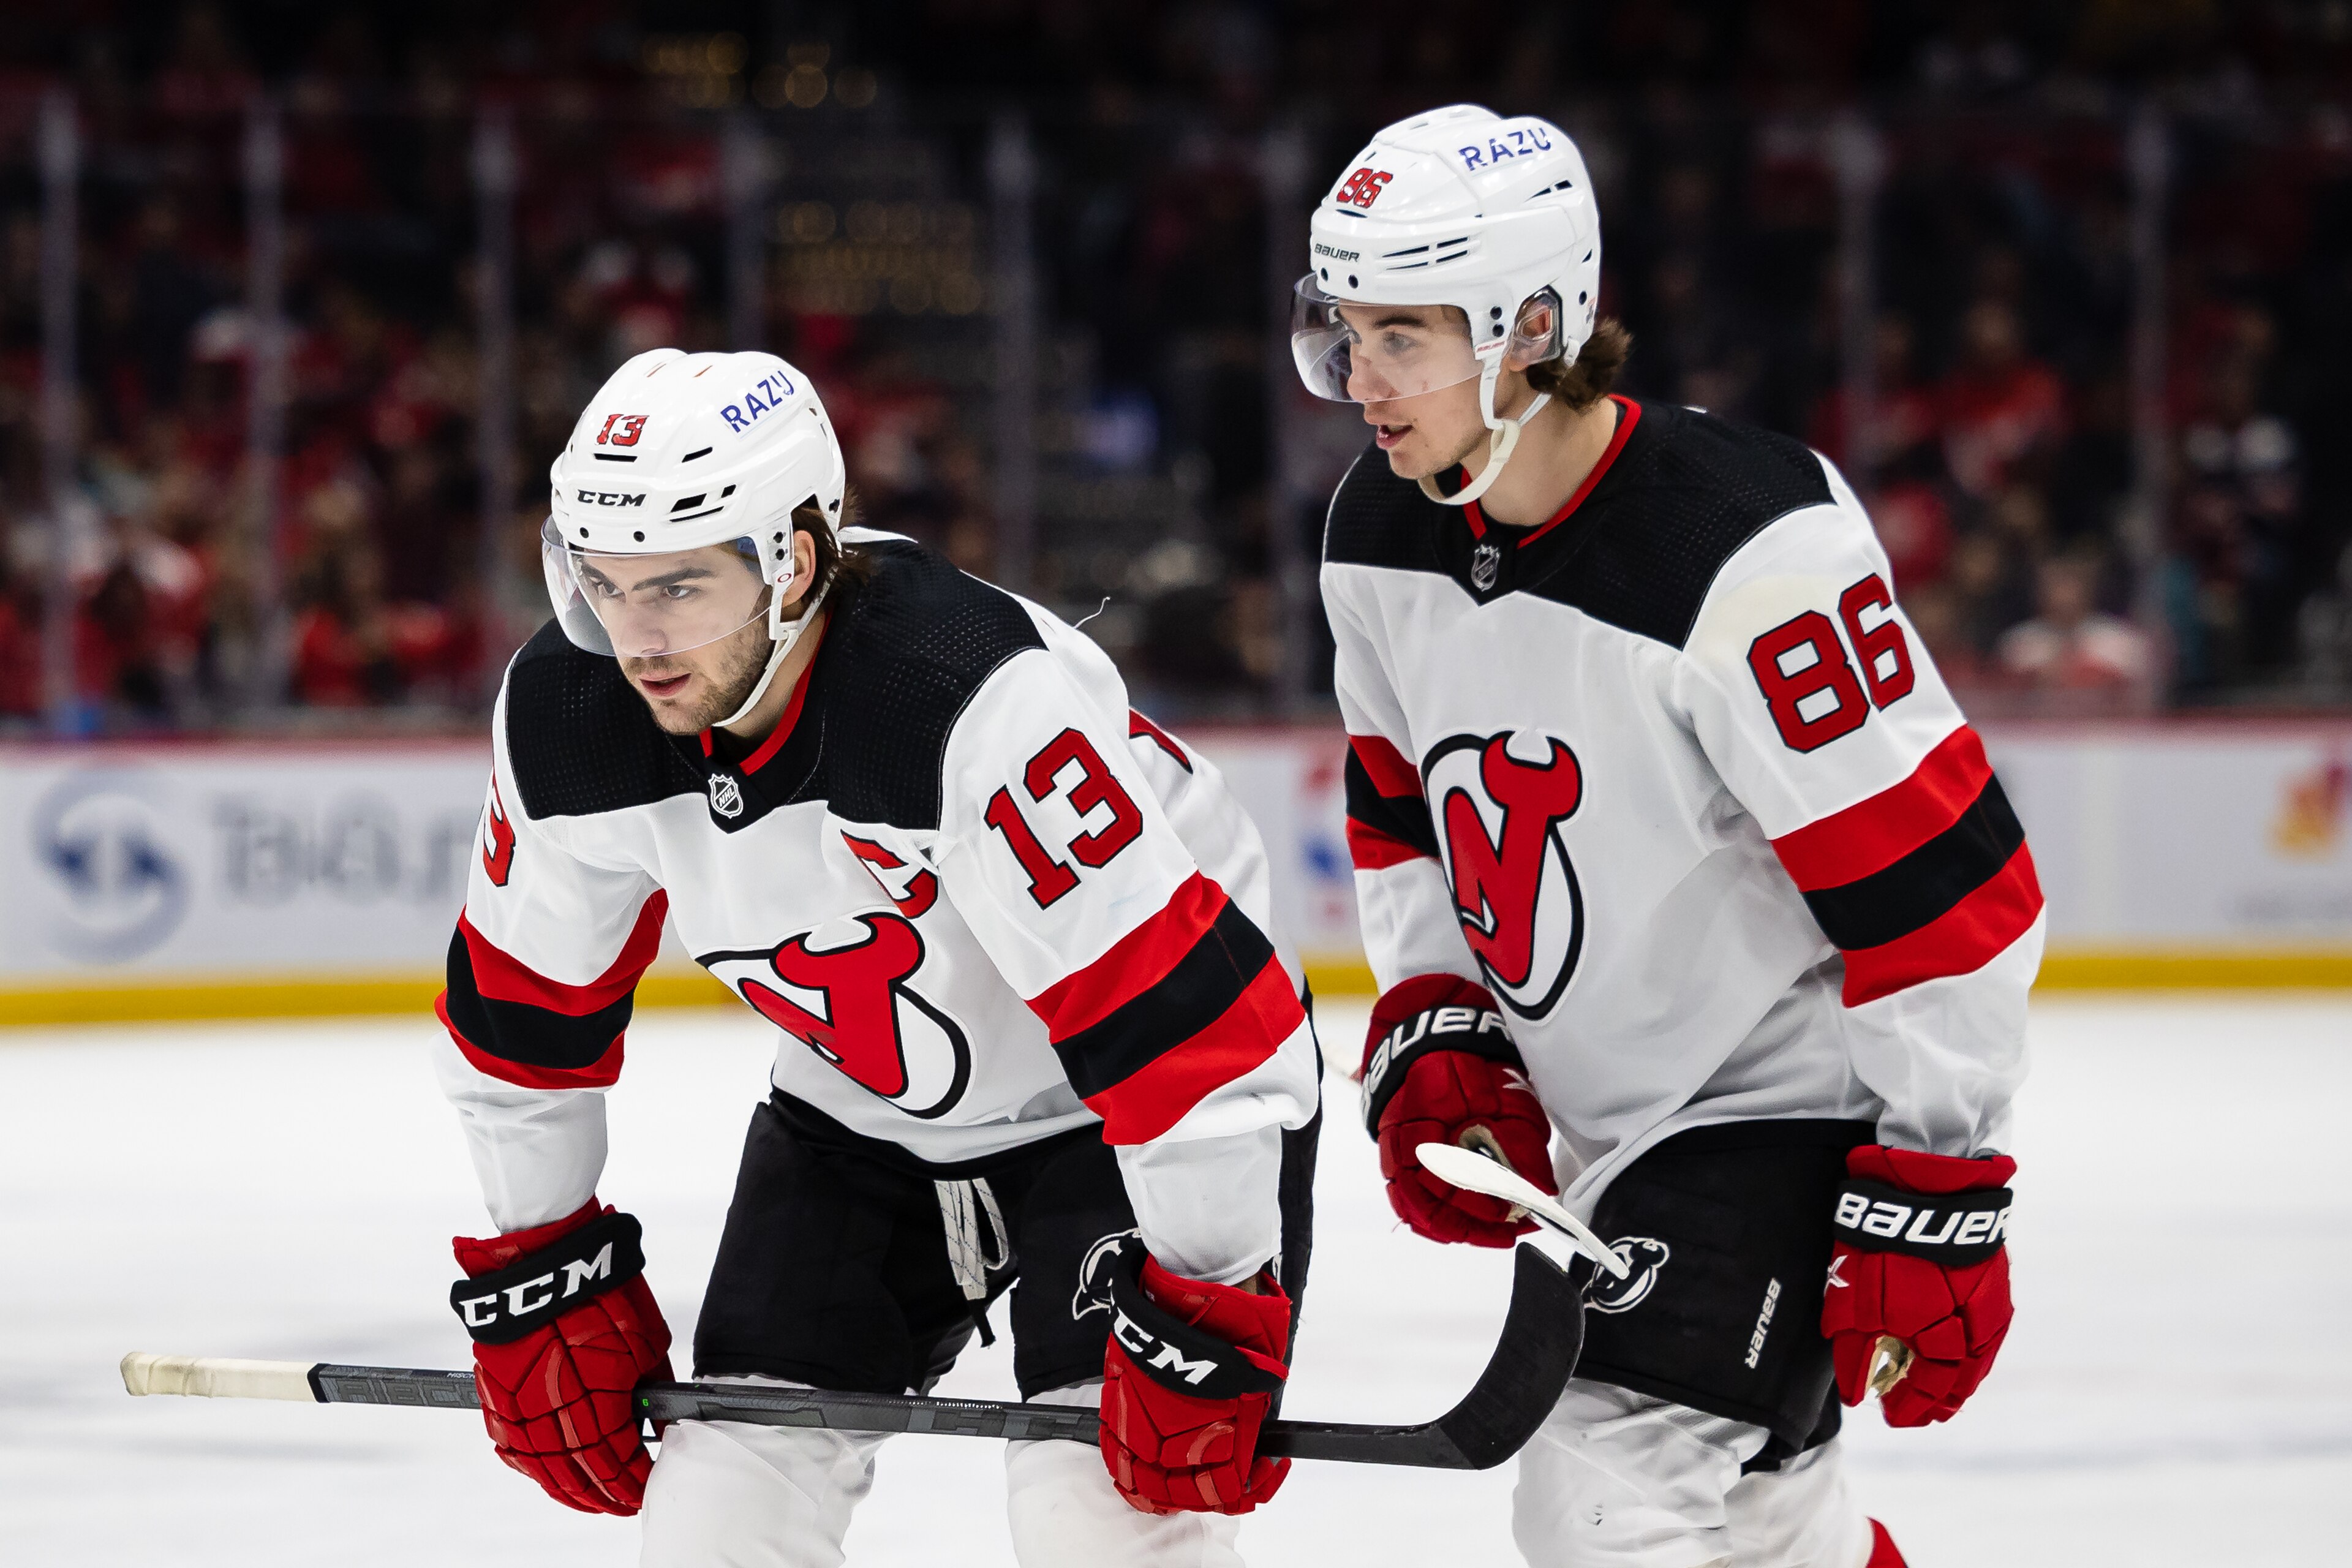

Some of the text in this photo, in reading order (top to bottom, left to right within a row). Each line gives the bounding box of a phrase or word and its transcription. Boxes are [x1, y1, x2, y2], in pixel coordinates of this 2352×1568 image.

[595, 413, 650, 447] 13
[577, 489, 647, 508] CCM
[1747, 573, 1915, 753] 86
[718, 786, 736, 807] NHL
[984, 727, 1143, 910] 13
[840, 828, 939, 919] C
[459, 1241, 613, 1327] CCM
[1110, 1286, 1218, 1385] CM
